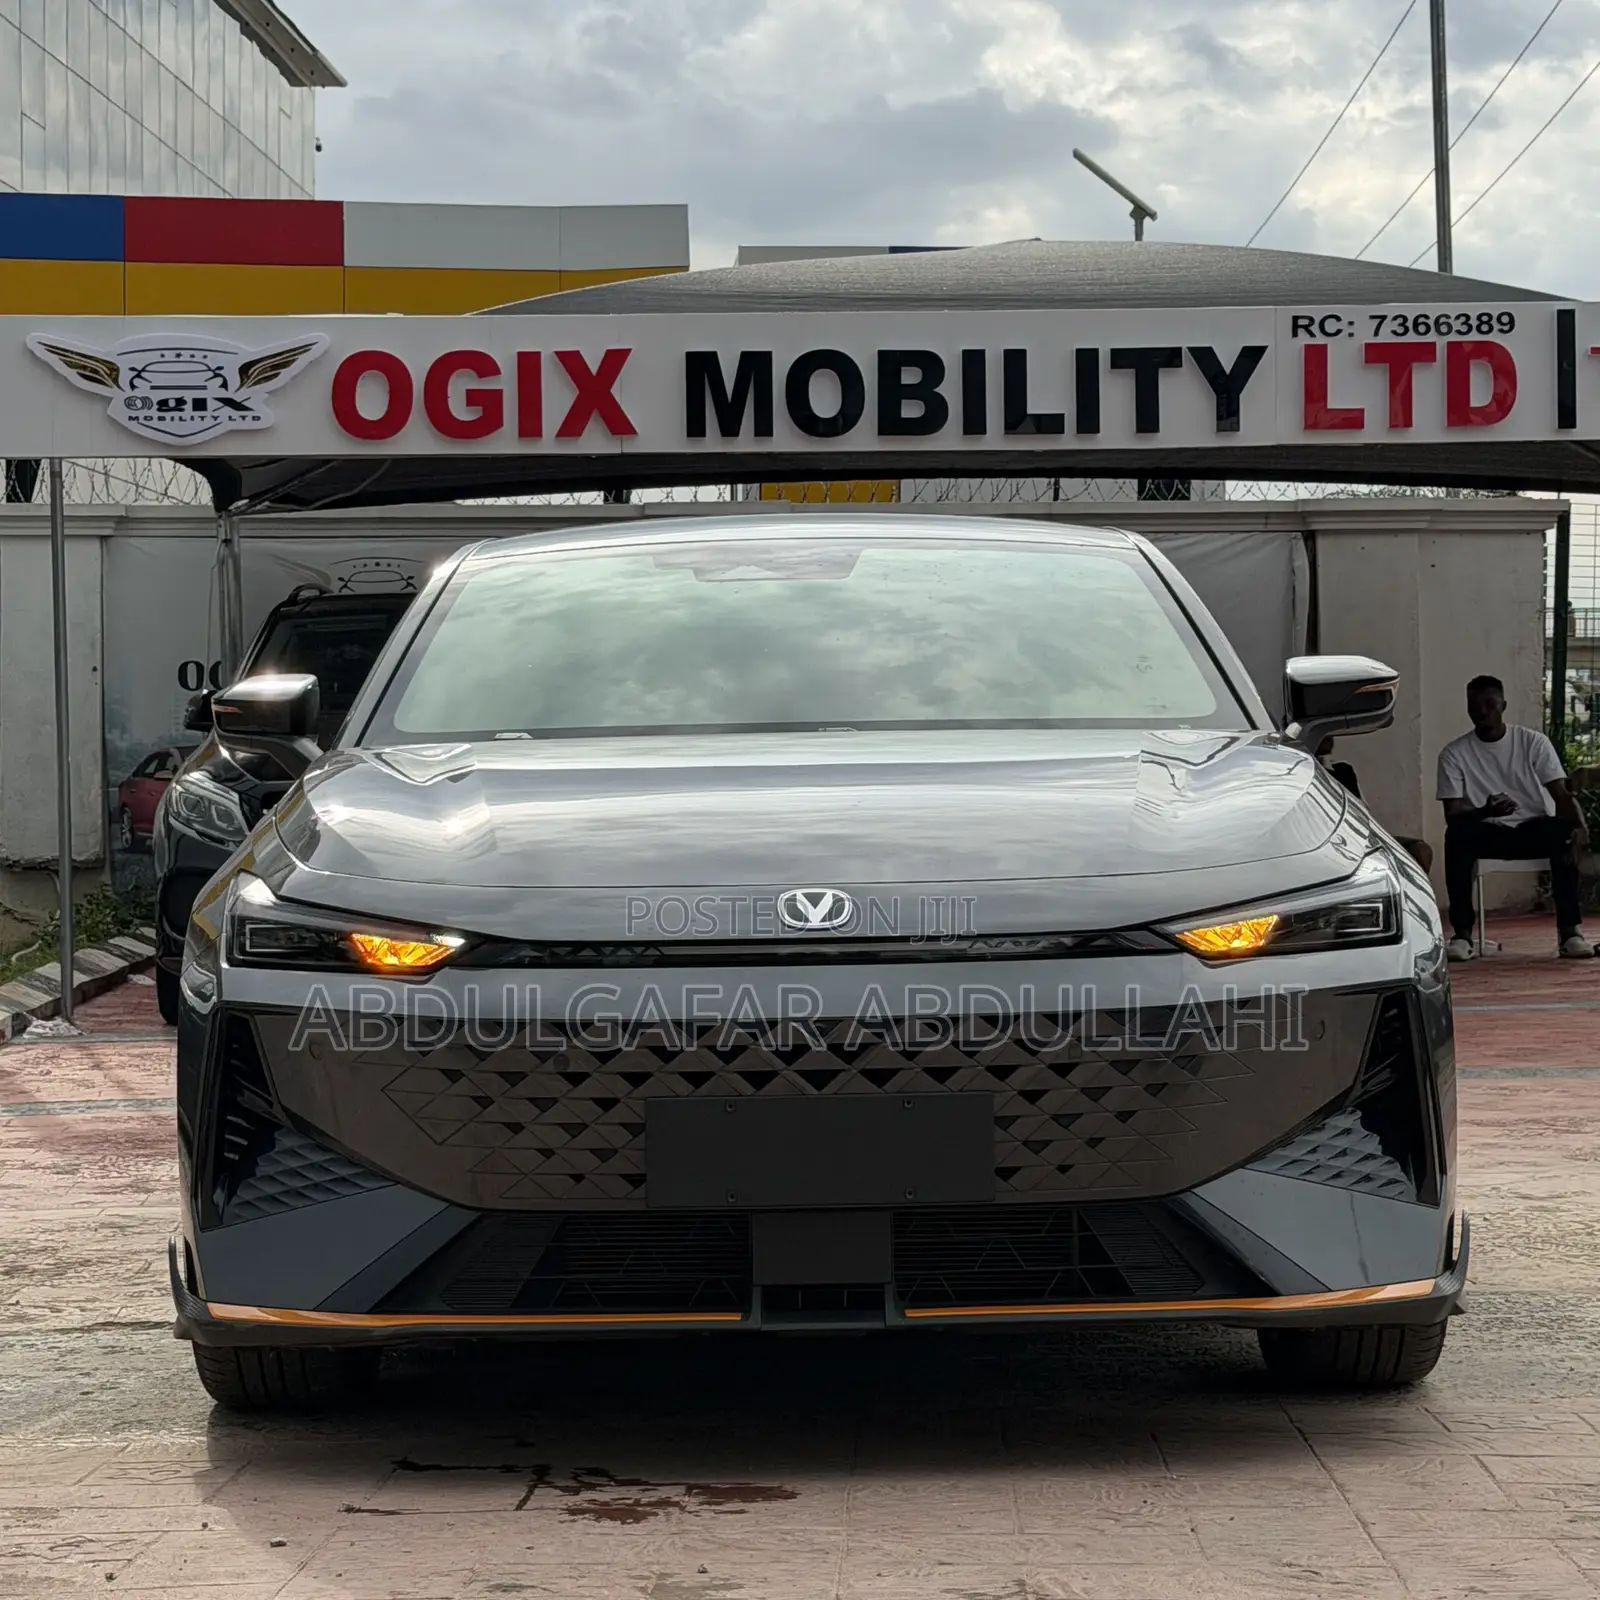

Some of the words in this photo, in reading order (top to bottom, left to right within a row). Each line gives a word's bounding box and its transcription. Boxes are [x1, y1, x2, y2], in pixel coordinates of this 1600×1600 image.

[1291, 314, 1355, 338] RC:
[1368, 311, 1516, 337] 7366389
[331, 348, 639, 441] OGIX
[685, 345, 1268, 438] MOBILITY
[1303, 340, 1518, 430] LTD
